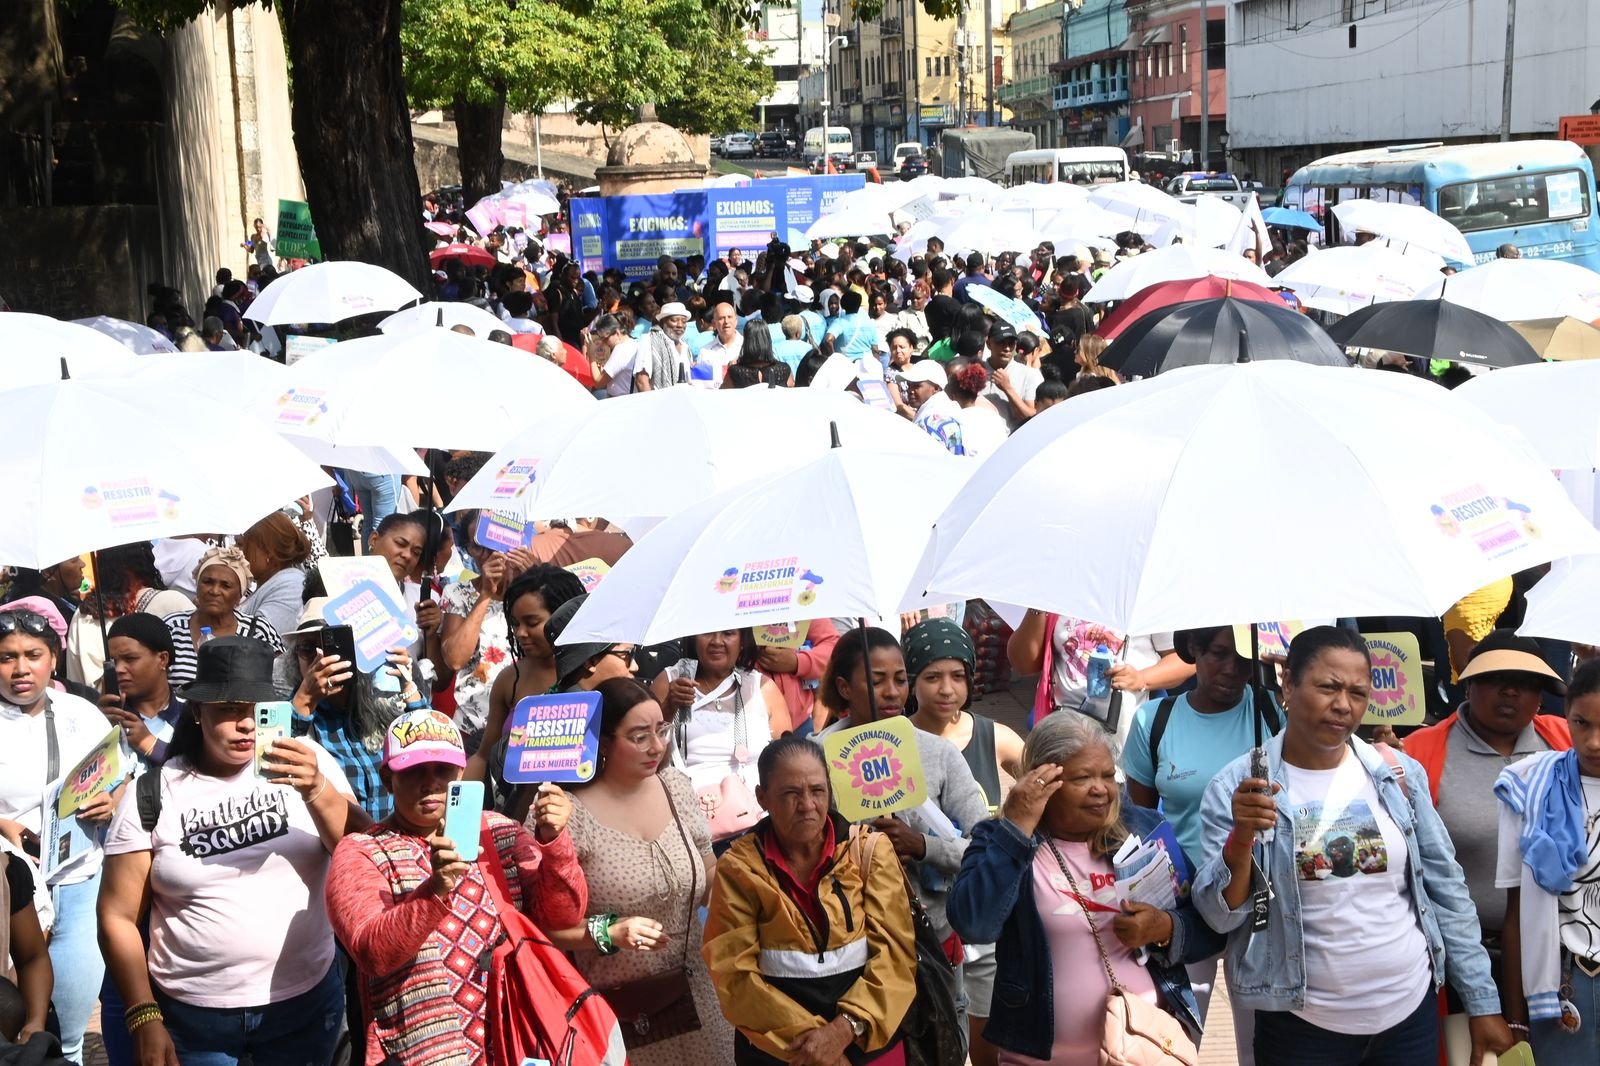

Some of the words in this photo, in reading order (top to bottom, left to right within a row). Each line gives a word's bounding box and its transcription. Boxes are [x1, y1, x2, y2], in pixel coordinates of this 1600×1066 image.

[716, 200, 775, 216] EXIGIMOS:
[629, 216, 689, 232] EXIGIMOS:
[102, 486, 151, 500] RESISTIR
[1450, 496, 1499, 522] RESISTIR
[744, 556, 798, 571] PERSISTIR
[741, 566, 796, 584] RESISTIR
[748, 599, 760, 607] LAS
[762, 596, 790, 606] MUJERES
[1366, 640, 1408, 662] TERNACIONAL
[1372, 668, 1396, 689] 8M
[528, 703, 588, 720] PERSISTIR
[1368, 704, 1376, 714] DE
[1377, 708, 1385, 718] LA
[1386, 704, 1406, 718] MUJER
[526, 718, 587, 738] RESISTIR
[524, 734, 584, 748] TRANSFORMAR
[840, 746, 852, 760] DÍA
[848, 730, 902, 749] INTERNACIONAL
[80, 760, 98, 784] 8M
[522, 761, 531, 769] DE
[533, 760, 546, 769] LAS
[548, 759, 578, 768] MUJERES
[861, 756, 891, 782] 8M
[861, 798, 870, 808] DE
[872, 799, 882, 809] LA
[883, 788, 905, 808] MUJER
[180, 786, 288, 838] Birthday
[189, 811, 283, 856] SQUAD
